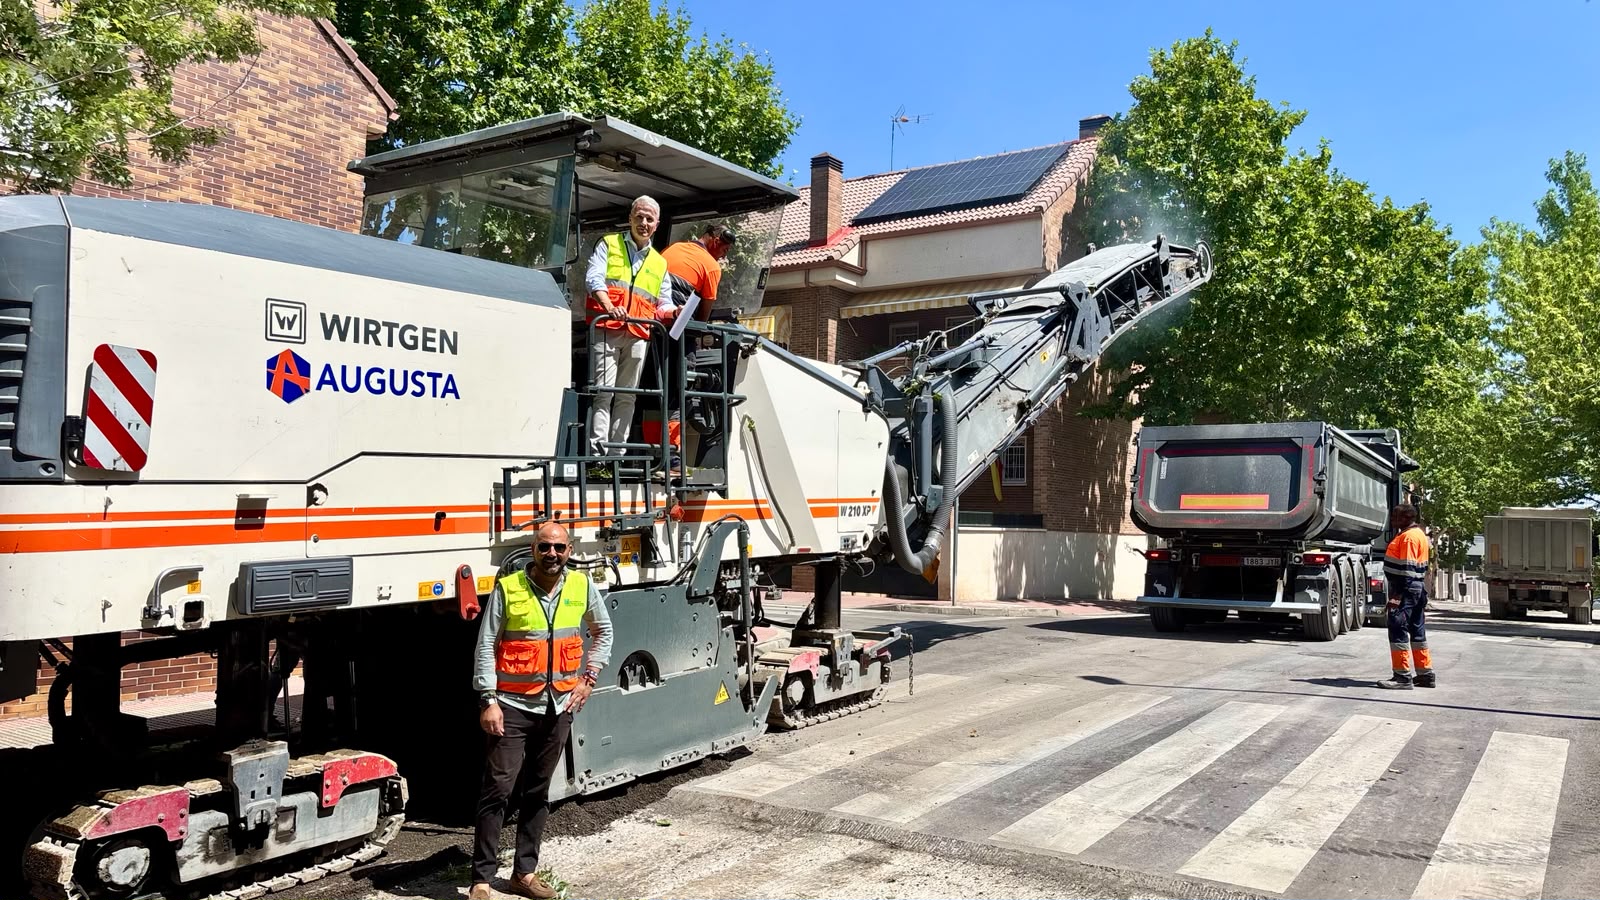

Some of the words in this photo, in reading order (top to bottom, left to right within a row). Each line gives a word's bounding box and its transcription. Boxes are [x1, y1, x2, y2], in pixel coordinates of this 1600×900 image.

[319, 312, 459, 356] WIRTGEN
[315, 363, 461, 400] AUGUSTA
[840, 505, 848, 517] W
[848, 505, 861, 517] 210
[861, 505, 871, 517] XP
[294, 577, 312, 592] W
